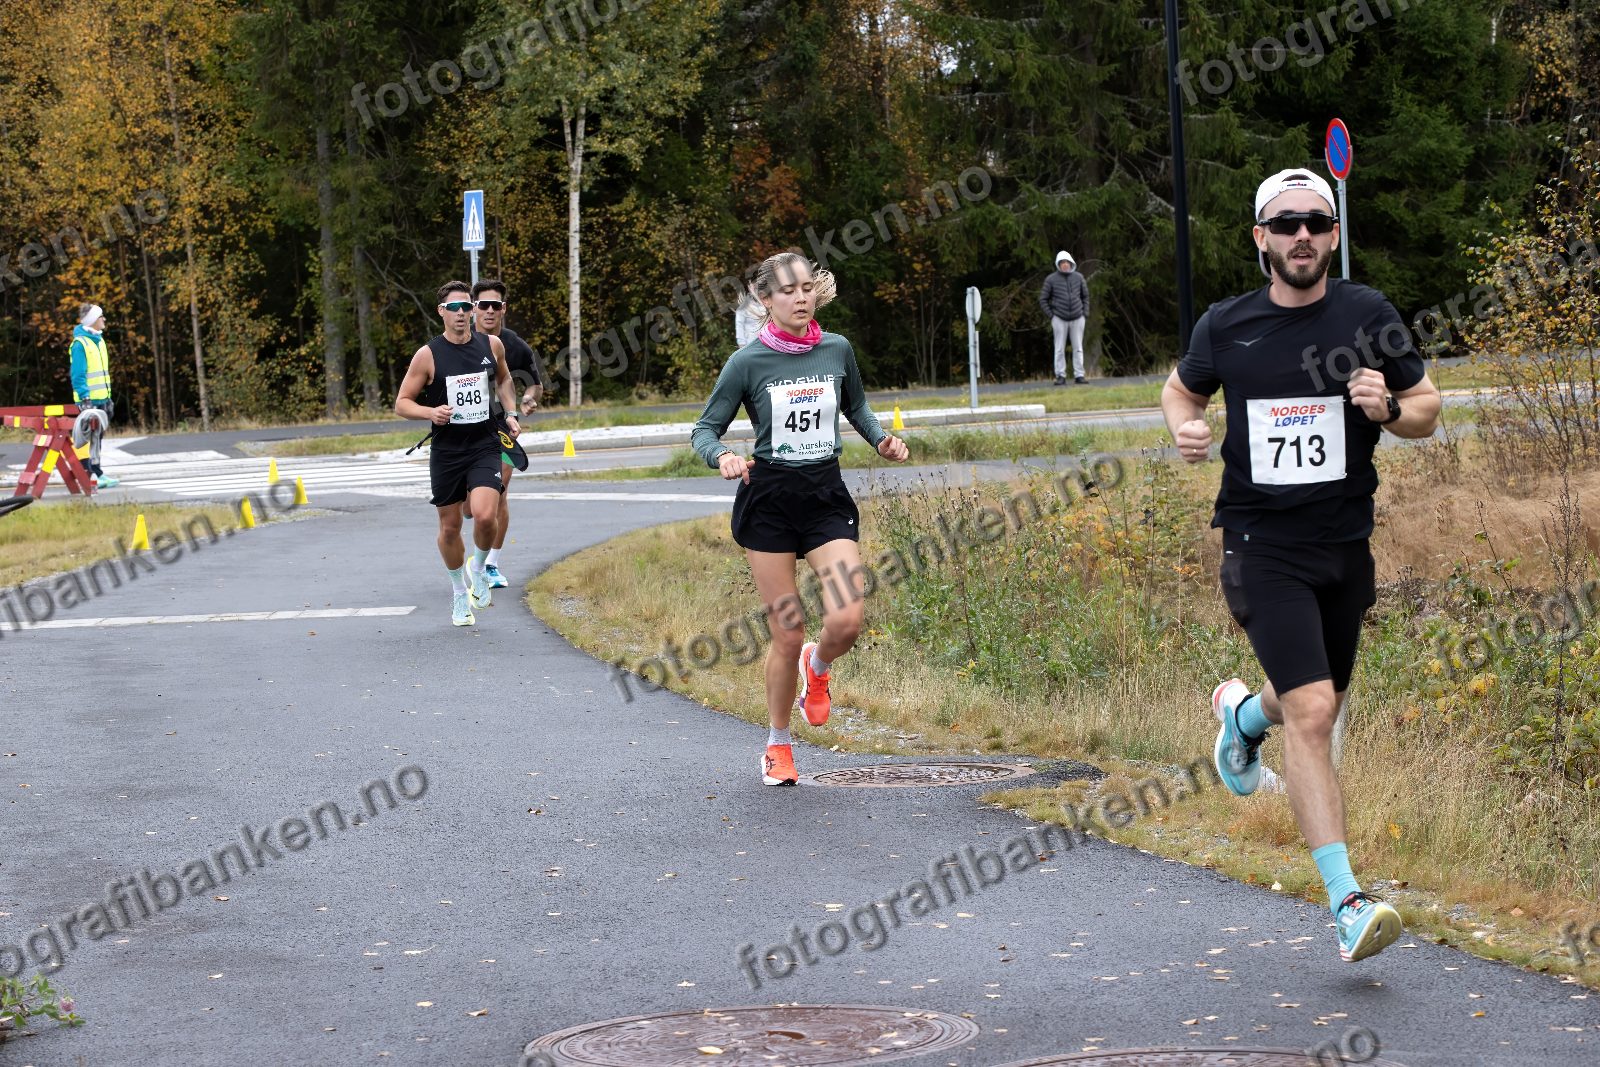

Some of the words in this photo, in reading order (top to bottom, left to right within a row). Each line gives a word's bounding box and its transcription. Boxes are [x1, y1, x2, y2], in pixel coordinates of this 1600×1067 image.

[456, 390, 482, 406] 848
[786, 388, 824, 397] NORGES
[790, 395, 819, 404] LØPET
[1268, 404, 1326, 417] NORGES
[784, 409, 821, 432] 451
[1274, 415, 1317, 427] LØPET
[1267, 434, 1326, 468] 713
